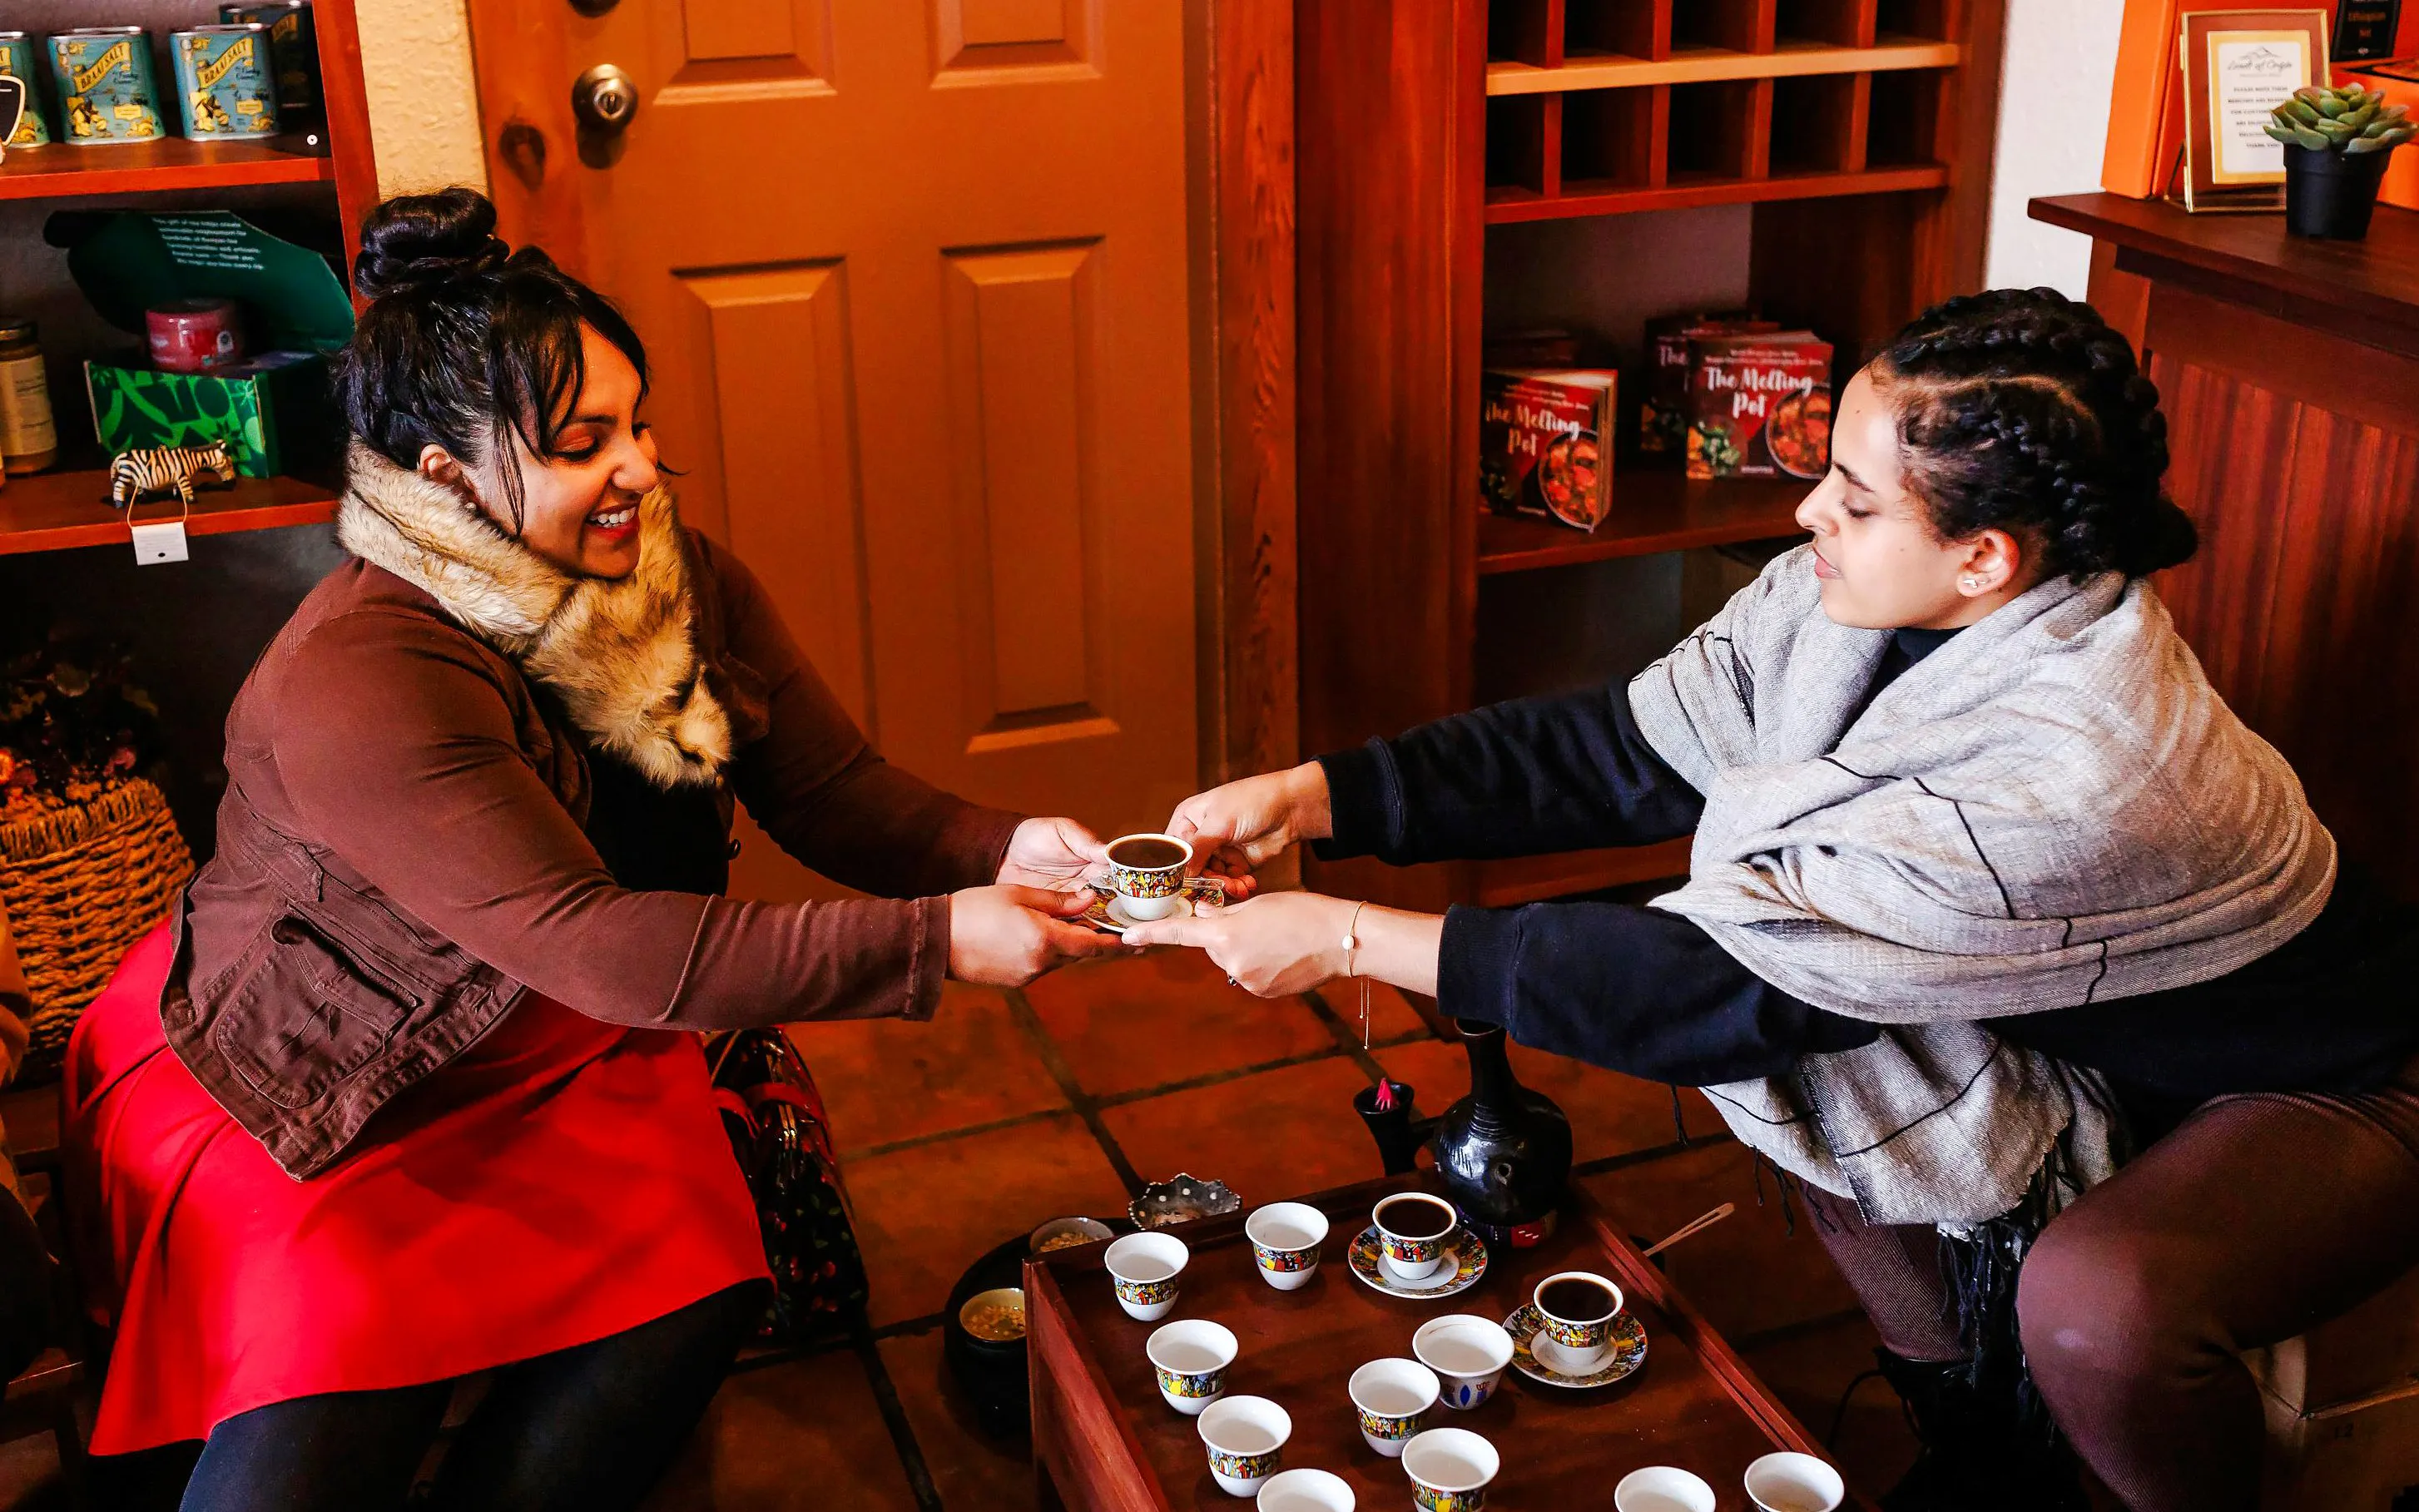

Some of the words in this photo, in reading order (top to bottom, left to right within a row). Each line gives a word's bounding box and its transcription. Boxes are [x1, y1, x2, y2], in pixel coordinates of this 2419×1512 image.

[1658, 344, 1688, 367] The
[1704, 366, 1736, 391] The
[1740, 368, 1813, 398] Melting
[1732, 392, 1767, 419] Pot
[1485, 400, 1509, 423] The
[1516, 404, 1580, 442] Melting
[1508, 428, 1538, 457] Pot
